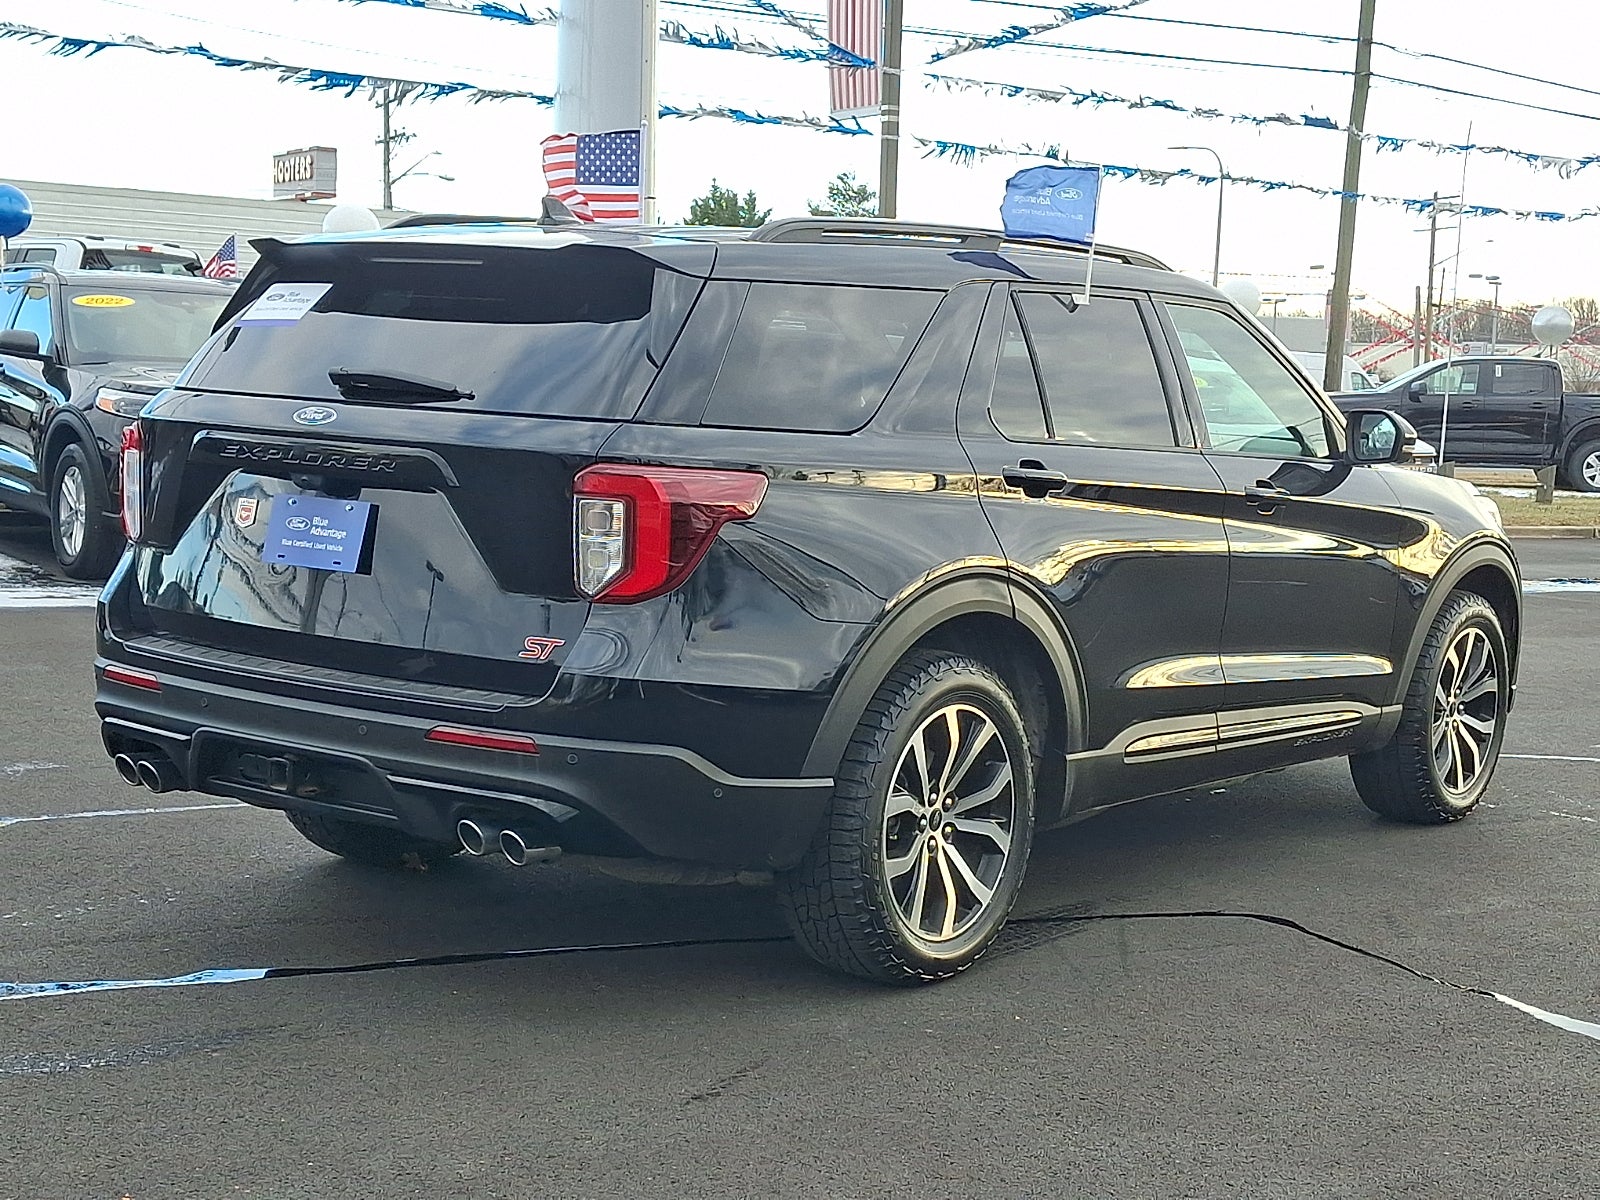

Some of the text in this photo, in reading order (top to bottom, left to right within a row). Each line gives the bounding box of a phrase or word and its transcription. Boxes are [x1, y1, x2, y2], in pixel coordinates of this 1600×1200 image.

[273, 154, 313, 184] HOOTERS
[85, 297, 124, 305] 2022
[219, 443, 398, 473] EXPLORER
[312, 516, 328, 526] Blue
[310, 526, 347, 539] Advantage
[517, 636, 566, 660] ST
